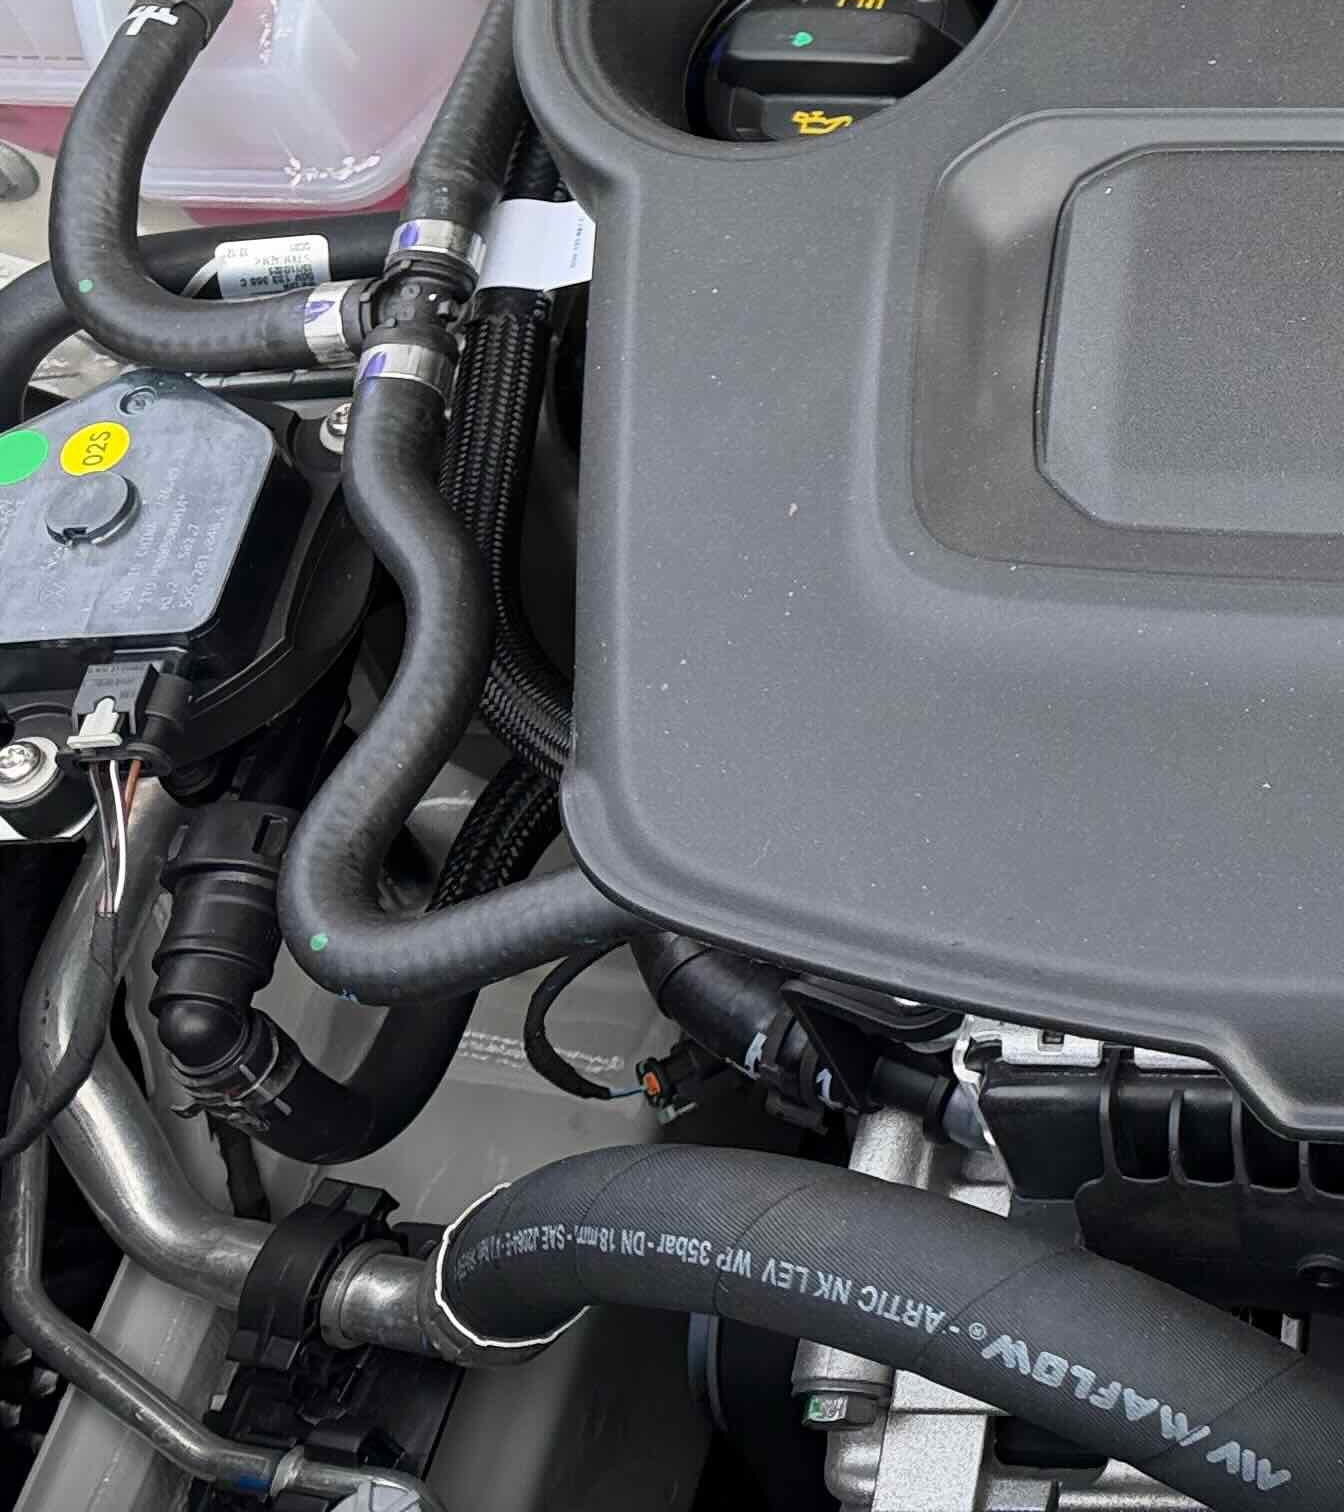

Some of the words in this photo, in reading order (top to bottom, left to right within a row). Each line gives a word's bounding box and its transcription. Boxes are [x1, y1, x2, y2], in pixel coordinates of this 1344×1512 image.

[81, 430, 112, 467] 02S
[541, 1223, 566, 1251] SAE
[760, 1257, 810, 1293] LEV
[813, 1270, 853, 1305] NK
